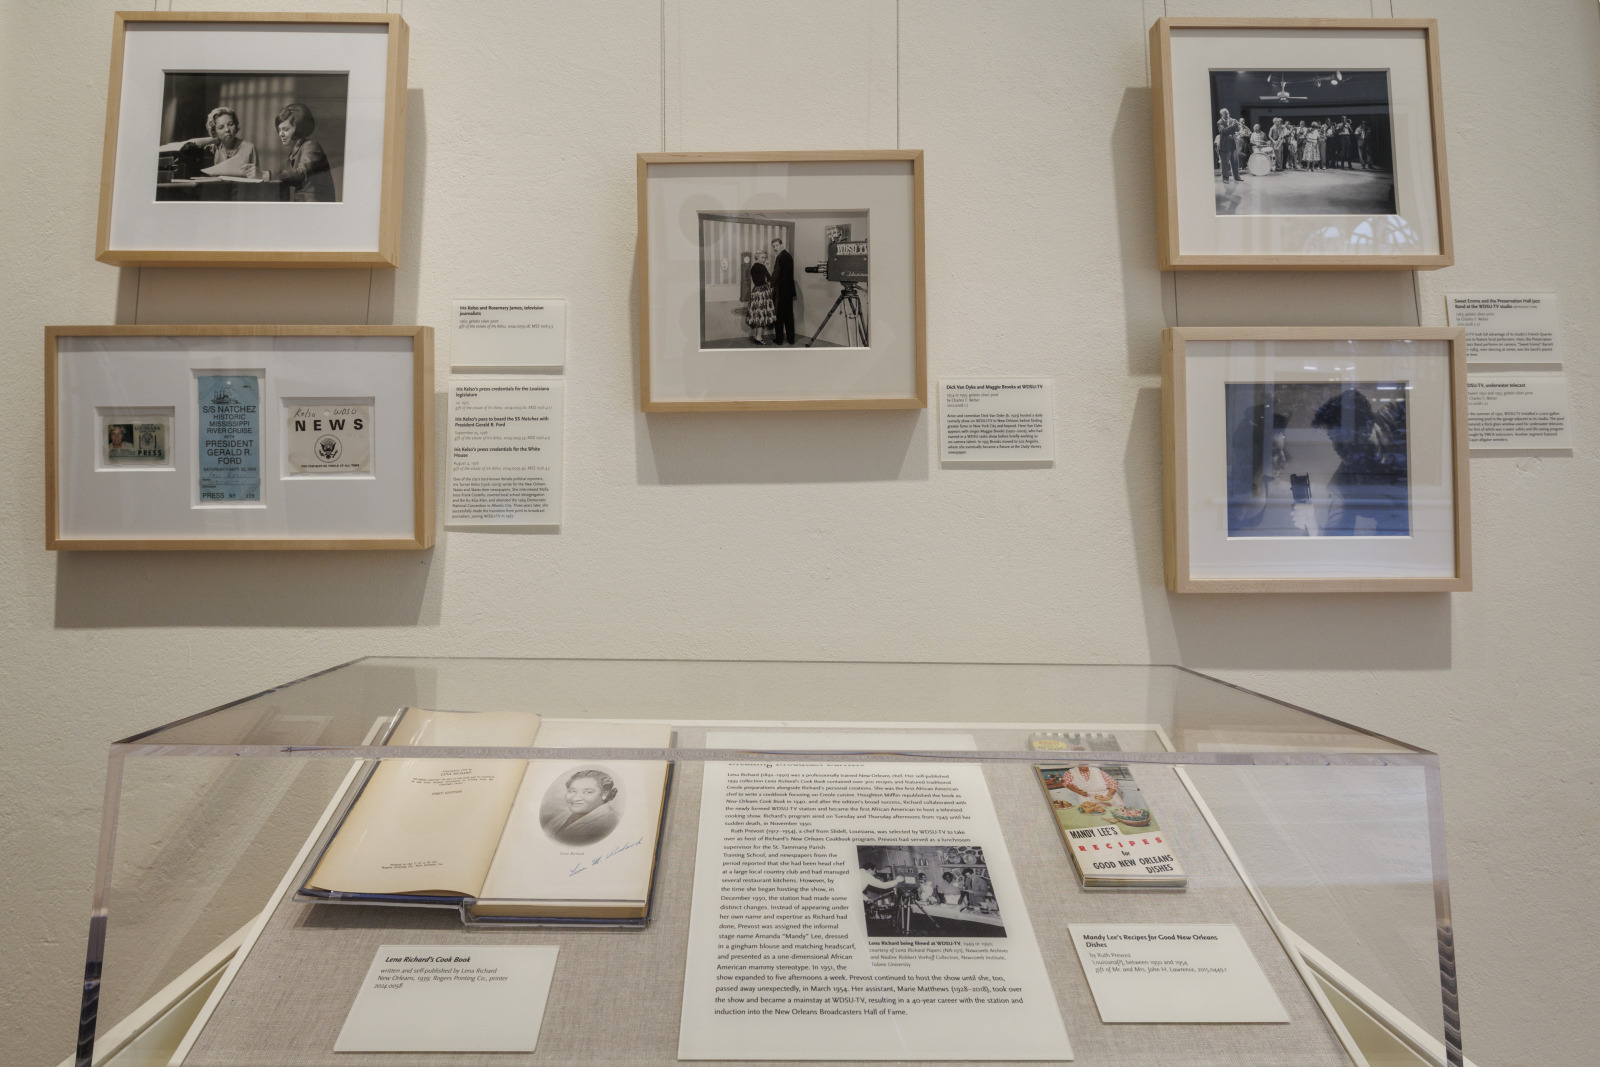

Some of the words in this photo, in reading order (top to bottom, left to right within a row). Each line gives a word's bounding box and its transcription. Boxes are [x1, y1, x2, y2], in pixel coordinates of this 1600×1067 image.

[295, 419, 363, 431] NEWS
[1069, 829, 1096, 839] MANDY
[1097, 827, 1118, 836] LEE'S
[1078, 837, 1162, 851] RECIPES
[1093, 861, 1116, 870] GOOD
[1139, 855, 1173, 865] ORLEANS
[1145, 864, 1173, 874] DISHES
[868, 997, 896, 1005] resulting
